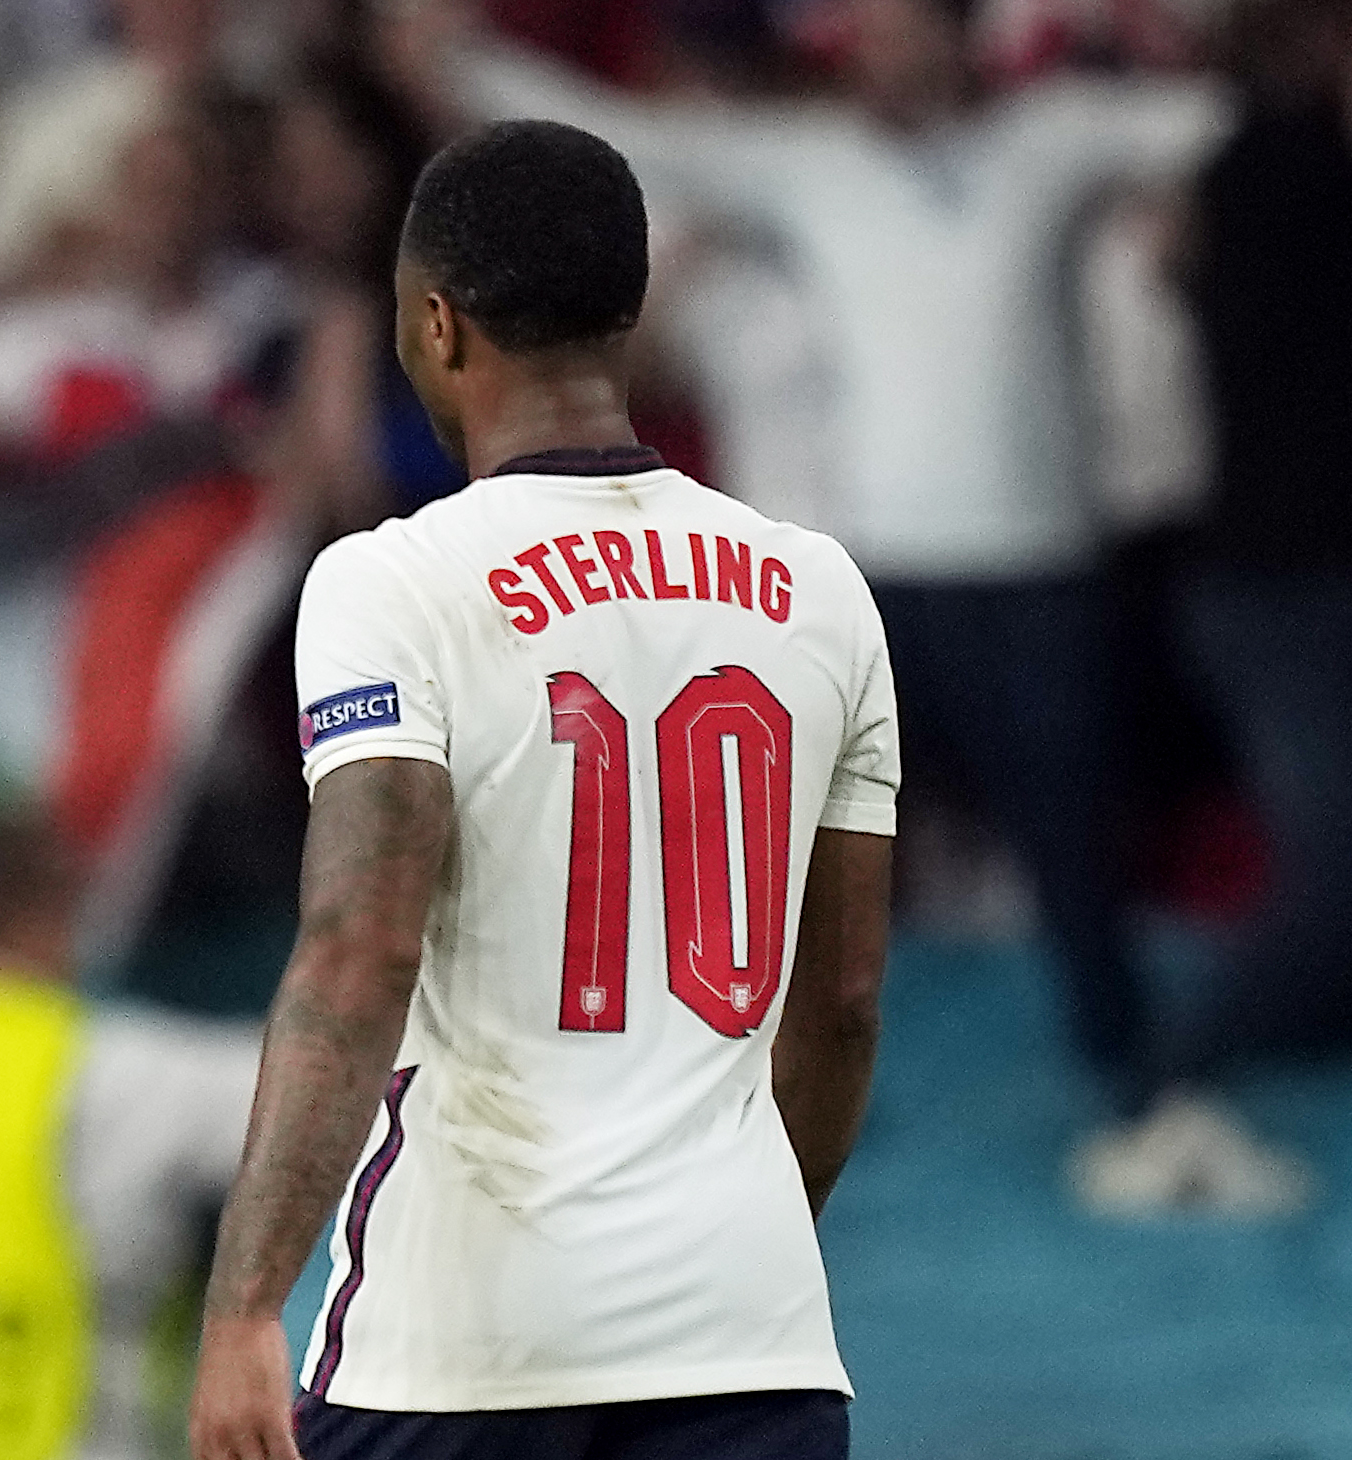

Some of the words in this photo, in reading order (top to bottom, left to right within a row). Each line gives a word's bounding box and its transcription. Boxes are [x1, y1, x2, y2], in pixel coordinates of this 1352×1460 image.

[488, 529, 793, 635] STERLING
[312, 692, 397, 733] RESPECT
[546, 665, 793, 1039] 10
